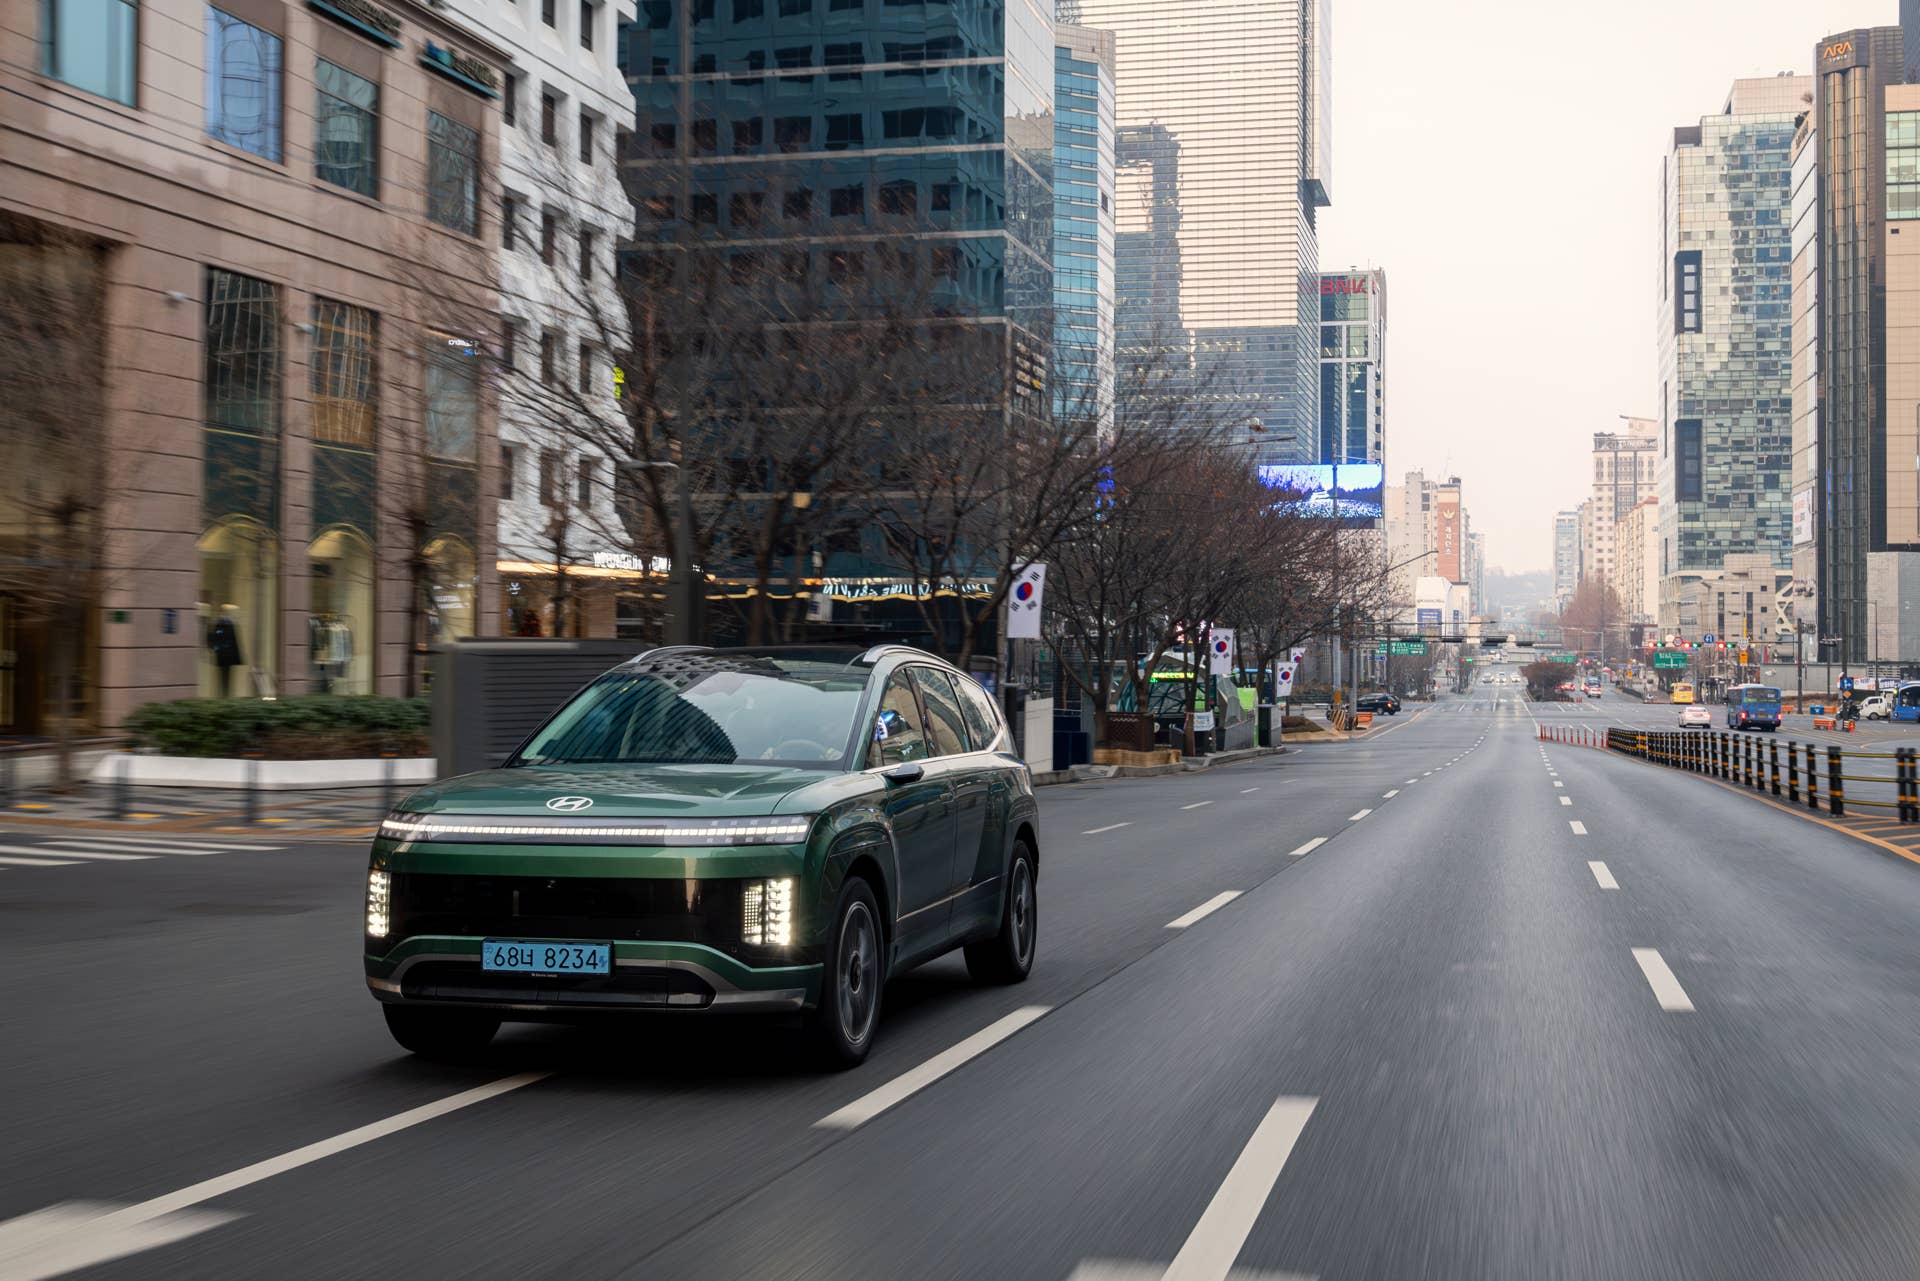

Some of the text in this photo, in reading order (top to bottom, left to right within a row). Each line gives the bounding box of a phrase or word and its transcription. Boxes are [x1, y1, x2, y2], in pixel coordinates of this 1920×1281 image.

[1823, 41, 1854, 59] ARA
[1320, 278, 1368, 295] BNK
[493, 946, 599, 970] 68너 8234
